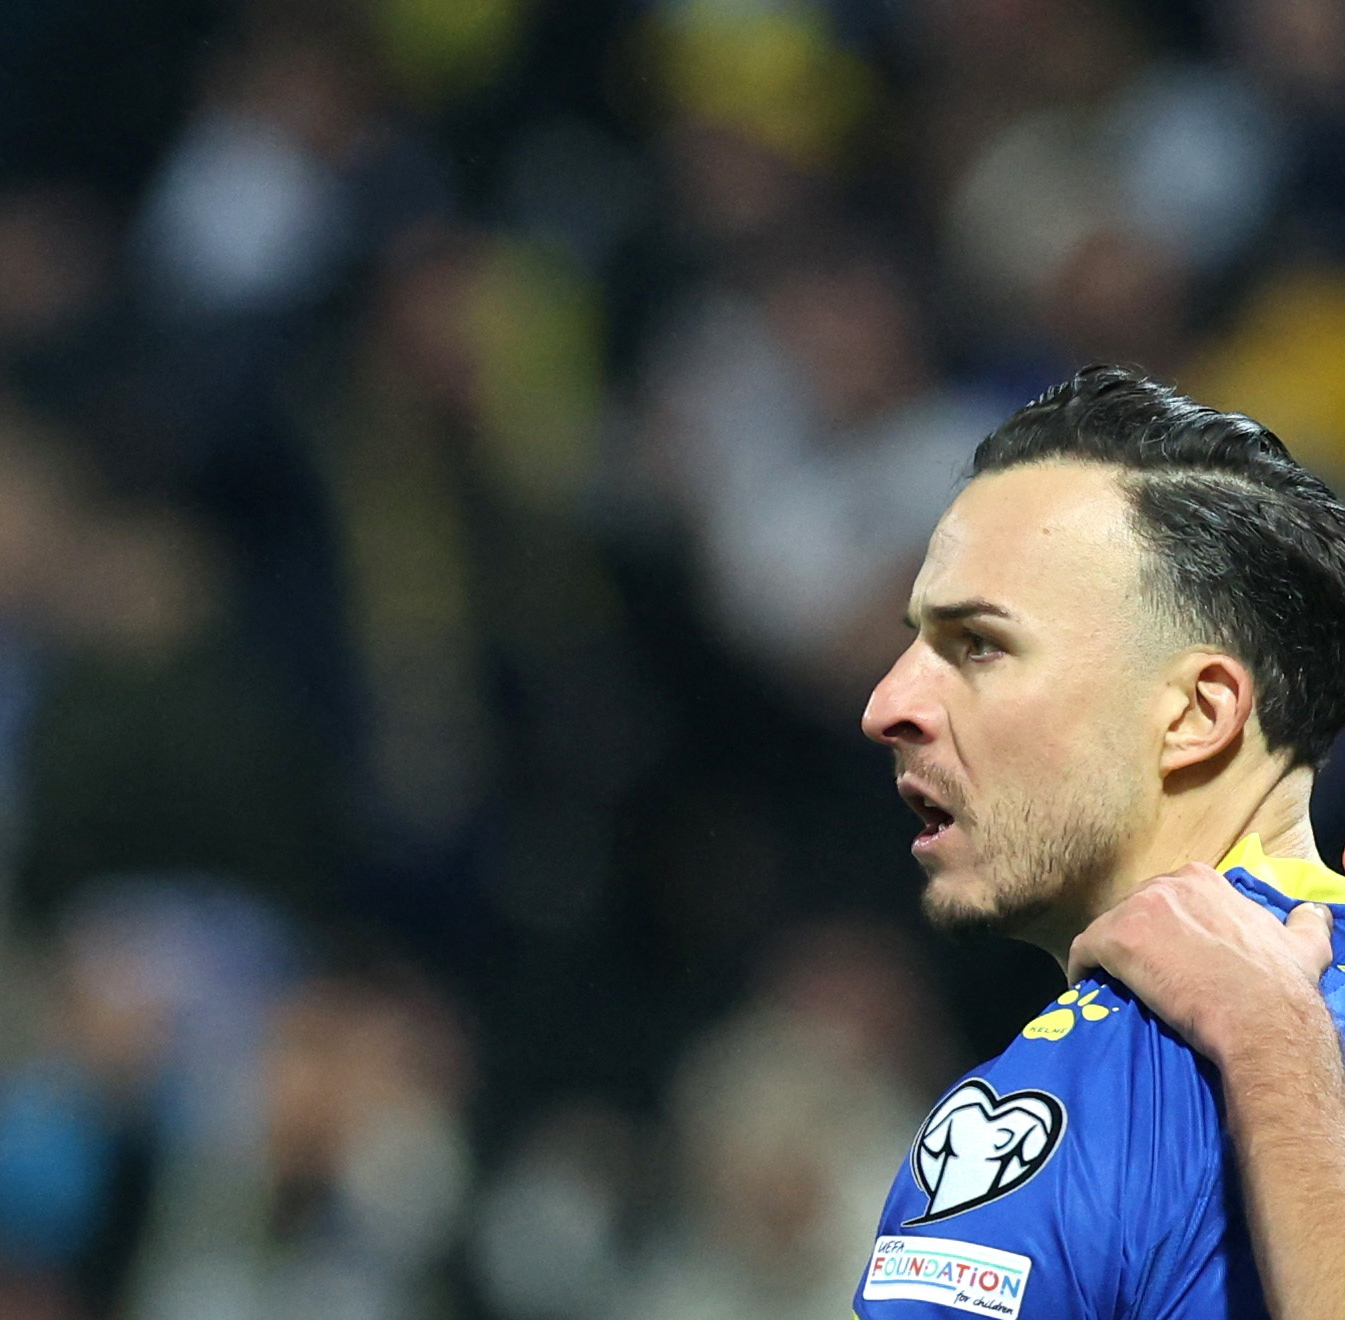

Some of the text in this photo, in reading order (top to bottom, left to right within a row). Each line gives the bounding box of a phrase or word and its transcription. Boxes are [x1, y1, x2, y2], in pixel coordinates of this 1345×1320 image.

[878, 1240, 905, 1254] UEFA
[954, 1290, 1014, 1315] for children
